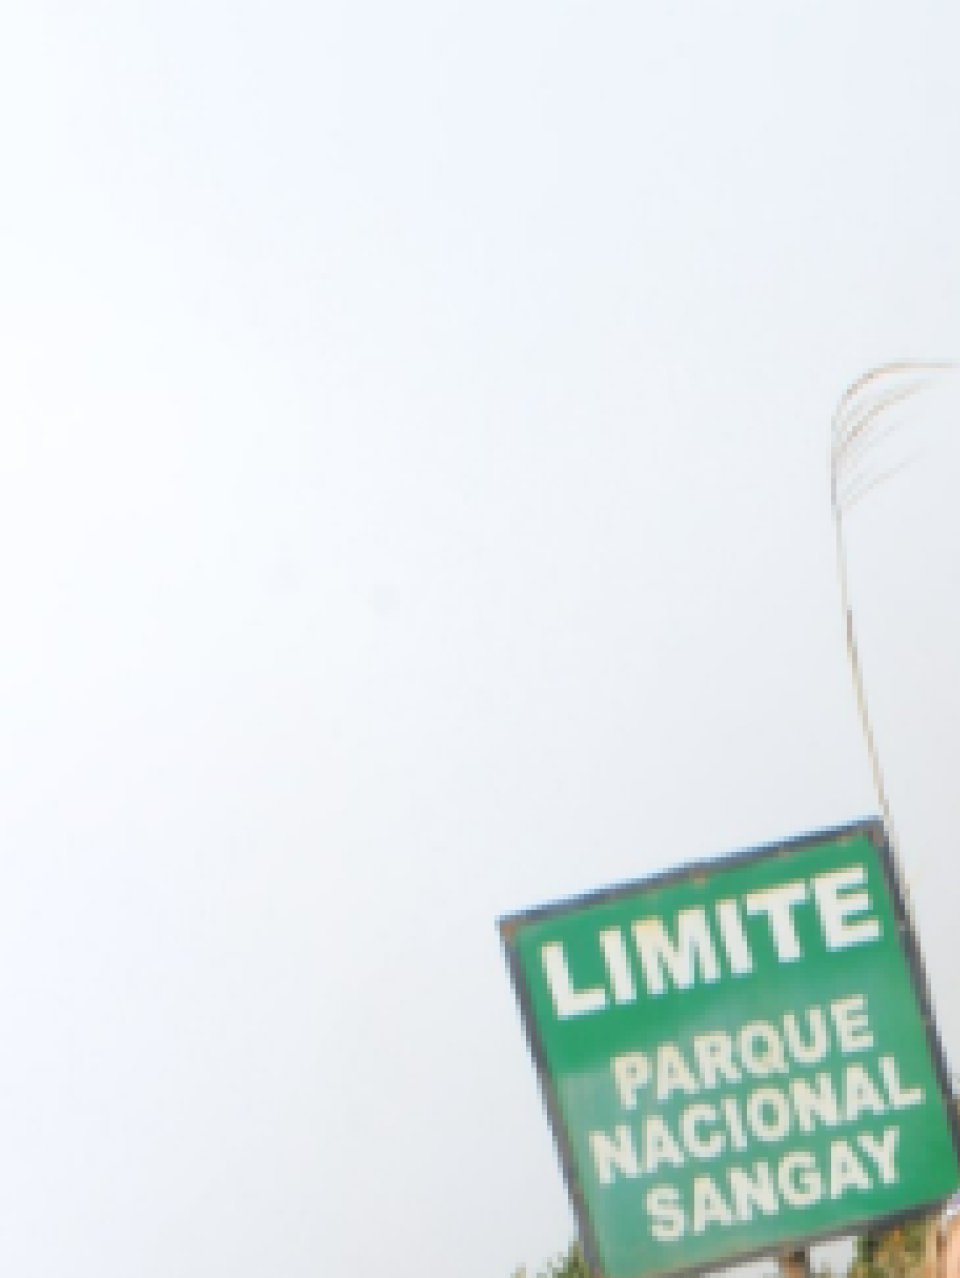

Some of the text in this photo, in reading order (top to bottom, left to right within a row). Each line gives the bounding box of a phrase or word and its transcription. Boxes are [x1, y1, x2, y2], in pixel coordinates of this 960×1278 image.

[541, 862, 884, 1020] LIMITE
[610, 994, 874, 1110] PARQUE
[589, 1056, 924, 1184] NACIONAL
[643, 1125, 900, 1242] SANGAY
